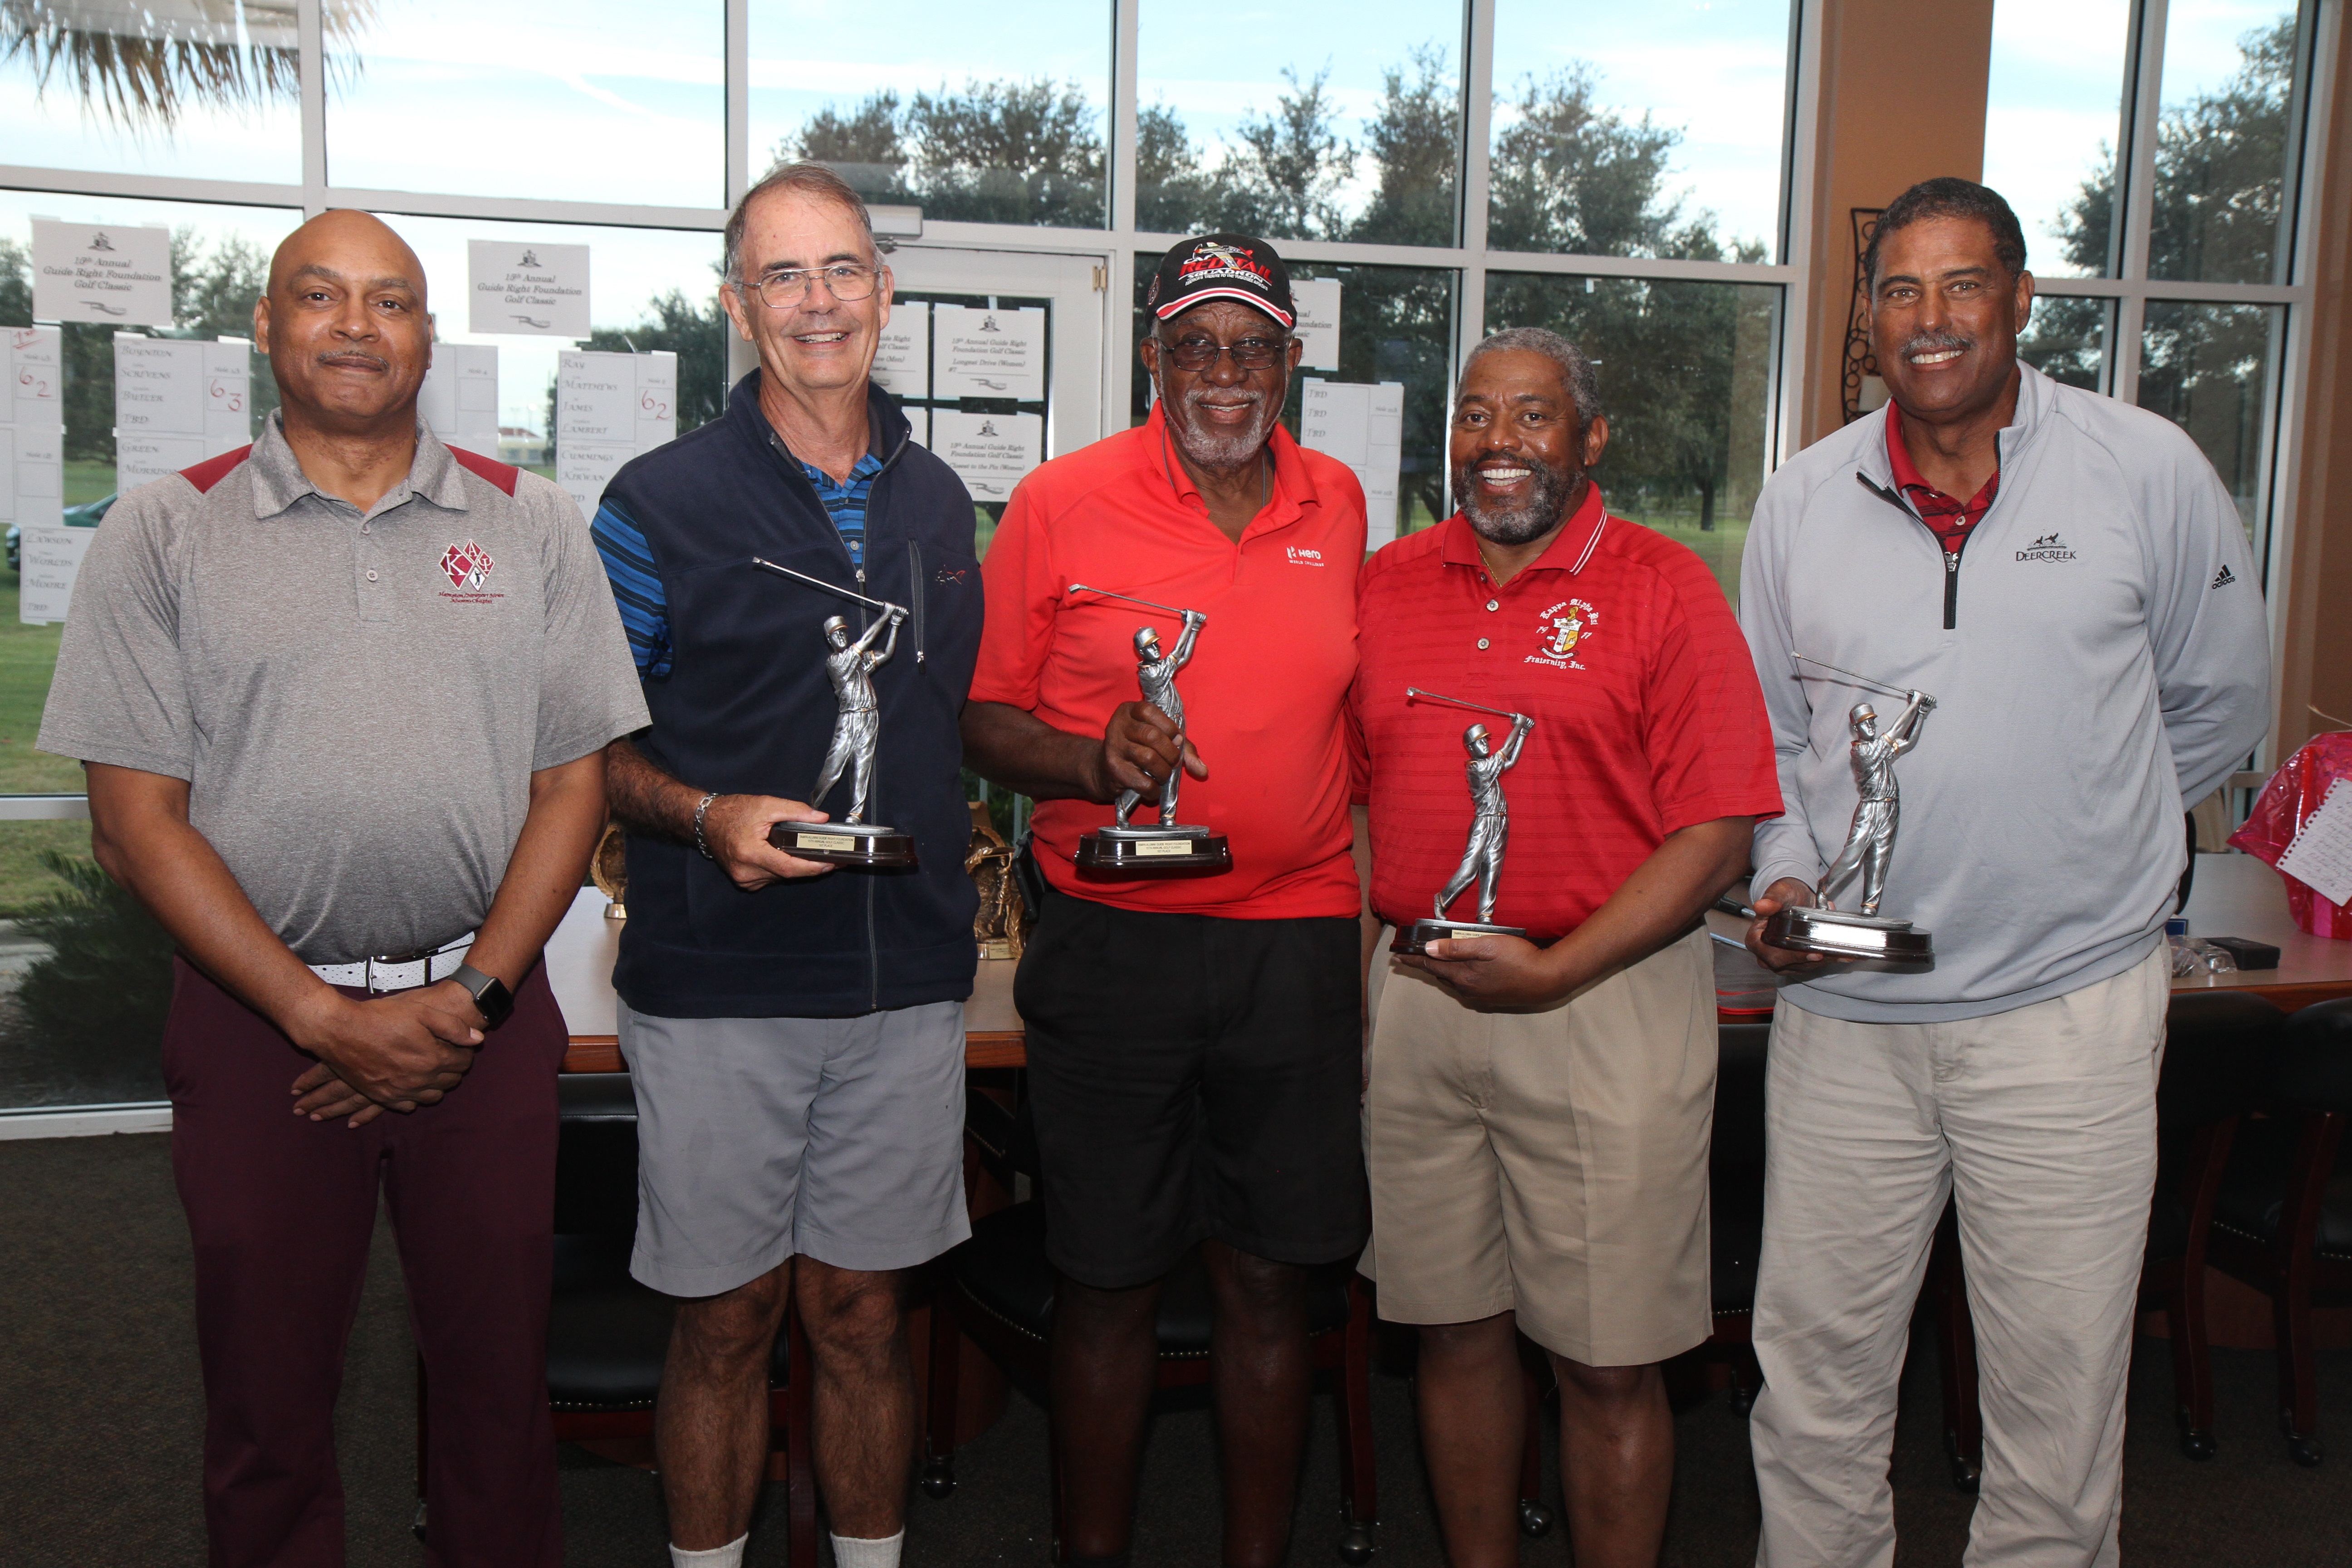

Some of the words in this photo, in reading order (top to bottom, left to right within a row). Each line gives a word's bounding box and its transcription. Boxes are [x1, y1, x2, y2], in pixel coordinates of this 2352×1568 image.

[94, 257, 131, 268] Annual
[43, 266, 73, 276] Guide
[75, 268, 103, 278] Right
[106, 270, 162, 281] Foundation
[1180, 257, 1225, 277] RED
[1234, 257, 1273, 284] TAIL
[1187, 269, 1263, 283] SQUADRON
[523, 274, 556, 283] Annual
[74, 279, 96, 289] Golf
[98, 280, 132, 291] Classic
[478, 282, 504, 292] Guide
[506, 284, 531, 294] Right
[534, 285, 582, 295] Foundation
[505, 295, 524, 304] Golf
[526, 296, 556, 305] Classic
[1296, 320, 1332, 328] oundation
[121, 345, 172, 357] BOYNTON
[563, 358, 585, 369] RAY
[953, 358, 978, 366] Longest
[20, 366, 53, 398] 62
[563, 380, 618, 391] MATTHEWS
[121, 390, 164, 402] BUTLER
[210, 378, 242, 412] 63
[1308, 389, 1328, 398] TBD
[563, 401, 593, 412] JAMES
[642, 389, 671, 420] 62
[1308, 409, 1327, 417] TBD
[563, 424, 608, 434] LAMBERT
[1307, 428, 1326, 437] TBD
[122, 442, 158, 452] GREEN
[561, 450, 613, 462] CUMMINGS
[122, 464, 177, 475] MORRISON
[572, 494, 585, 502] BD
[26, 533, 74, 545] LAWSON
[1298, 549, 1322, 560] Hero
[2016, 550, 2077, 564] DEERCREEK
[442, 552, 468, 576] K
[25, 577, 67, 590] MOORE
[2212, 575, 2236, 590] adidas
[1539, 602, 1567, 620] Kappa
[1569, 598, 1593, 612] Alpha
[1587, 612, 1599, 625] Psi
[1580, 632, 1592, 640] 11
[1524, 655, 1567, 670] Fraternity,
[1568, 660, 1586, 670] Inc.
